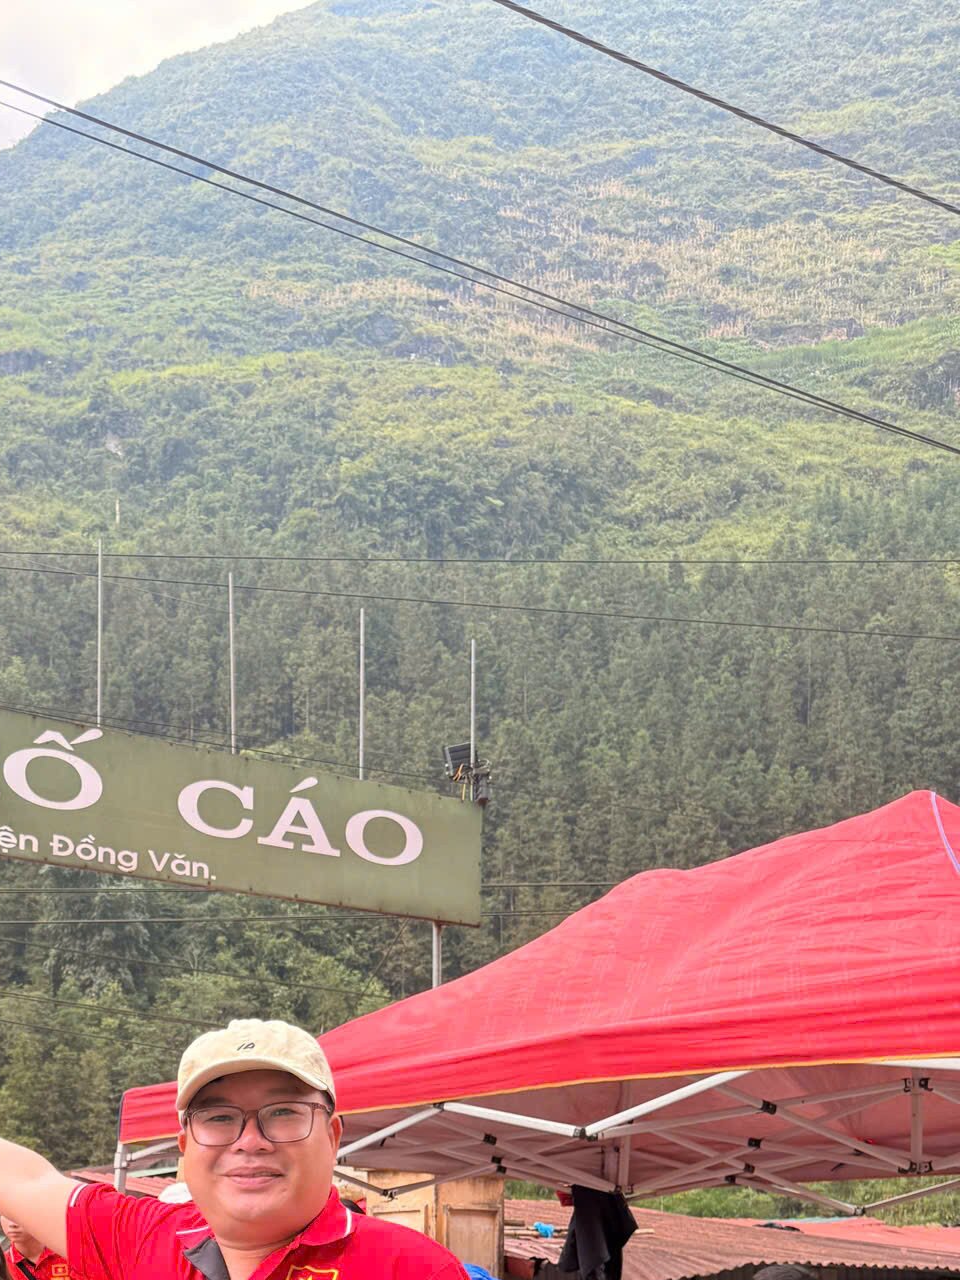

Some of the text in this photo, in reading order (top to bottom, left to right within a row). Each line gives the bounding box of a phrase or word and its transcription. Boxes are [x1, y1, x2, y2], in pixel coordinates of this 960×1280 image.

[177, 775, 424, 866] CÁO
[48, 833, 139, 873] Đồng
[147, 849, 217, 881] Văn.
